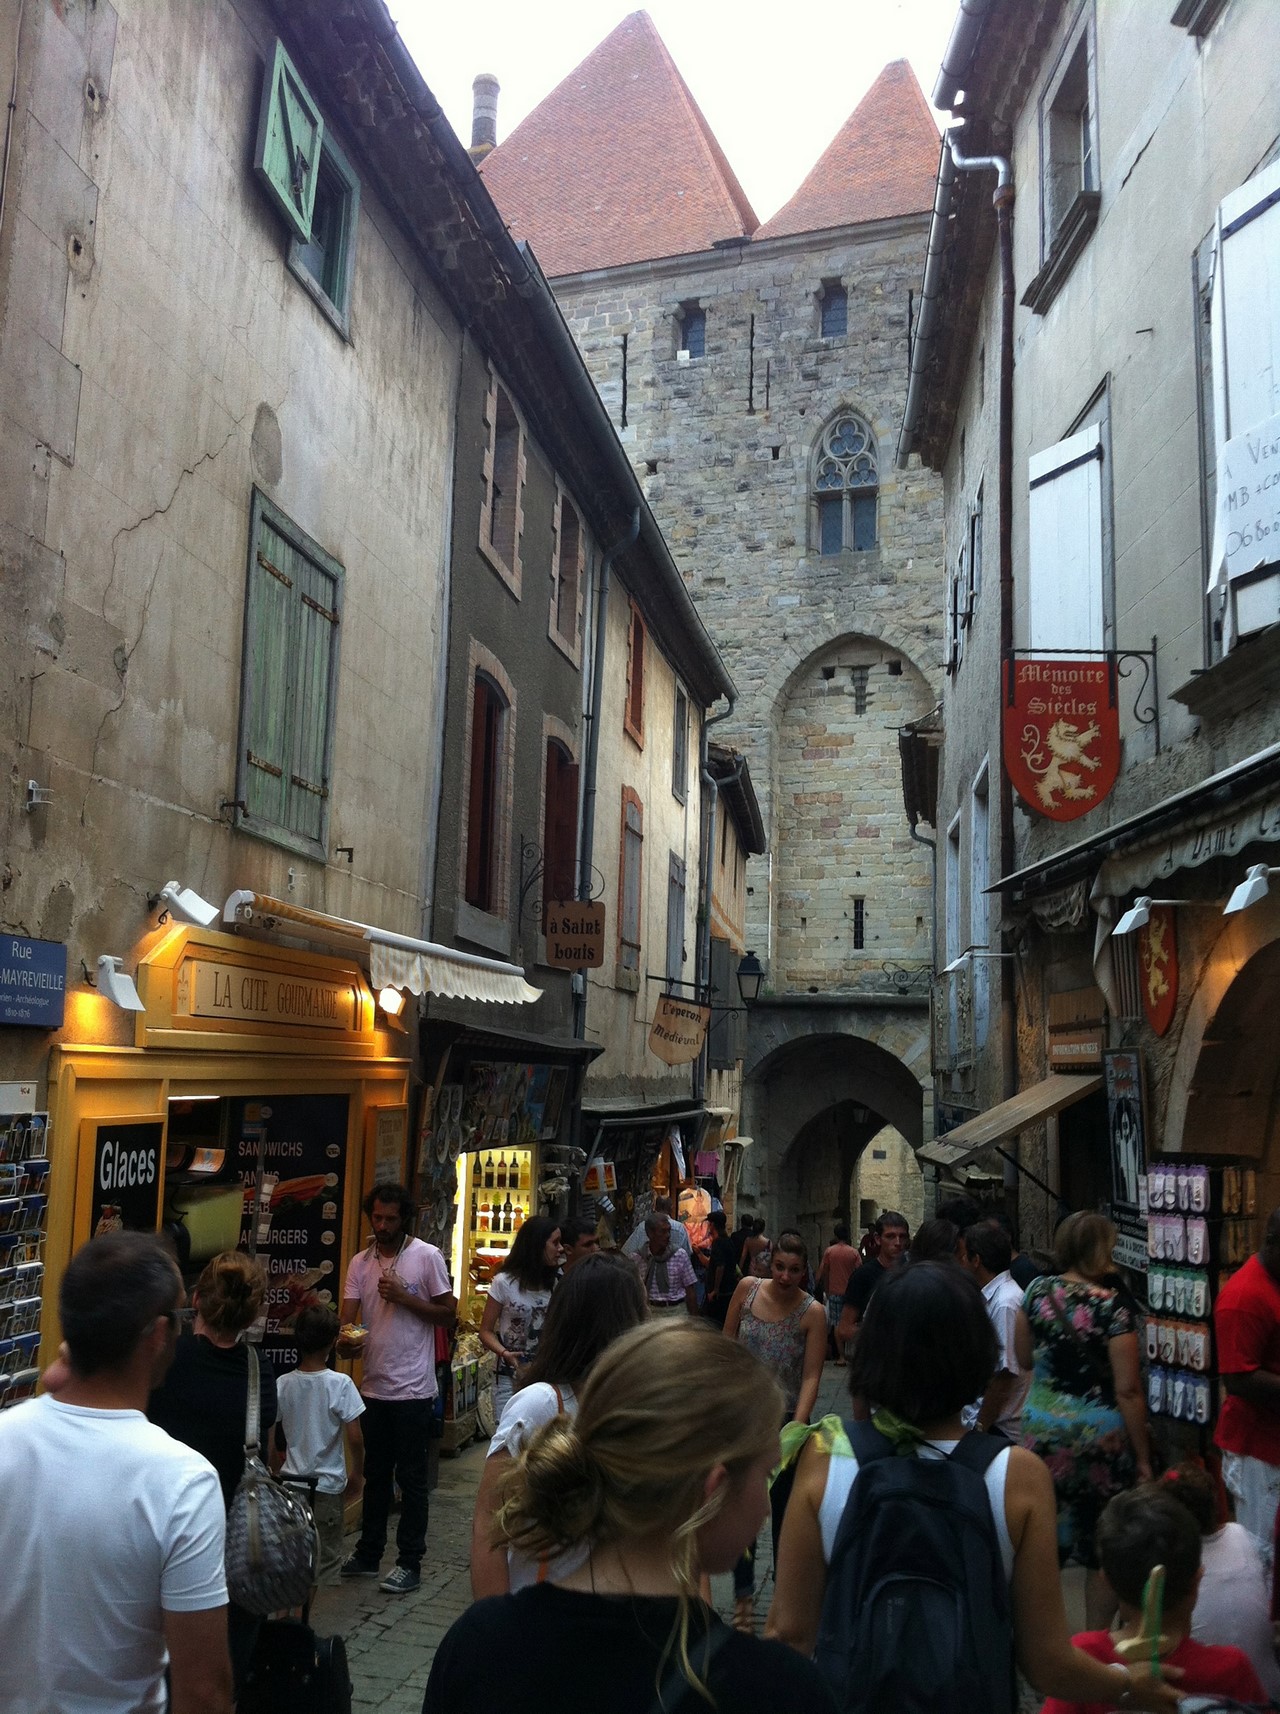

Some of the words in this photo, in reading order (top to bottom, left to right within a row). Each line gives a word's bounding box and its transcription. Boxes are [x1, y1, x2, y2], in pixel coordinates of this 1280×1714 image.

[1018, 663, 1105, 683] Mémoire
[1051, 683, 1072, 694] des
[1027, 696, 1097, 715] Siècles
[550, 917, 558, 934] à
[561, 917, 601, 935] Saint
[12, 941, 32, 959] Rue
[554, 942, 595, 960] Louis
[213, 971, 232, 1008] LA
[277, 982, 338, 1019] GOURMANDE
[100, 1140, 156, 1190] Glaces
